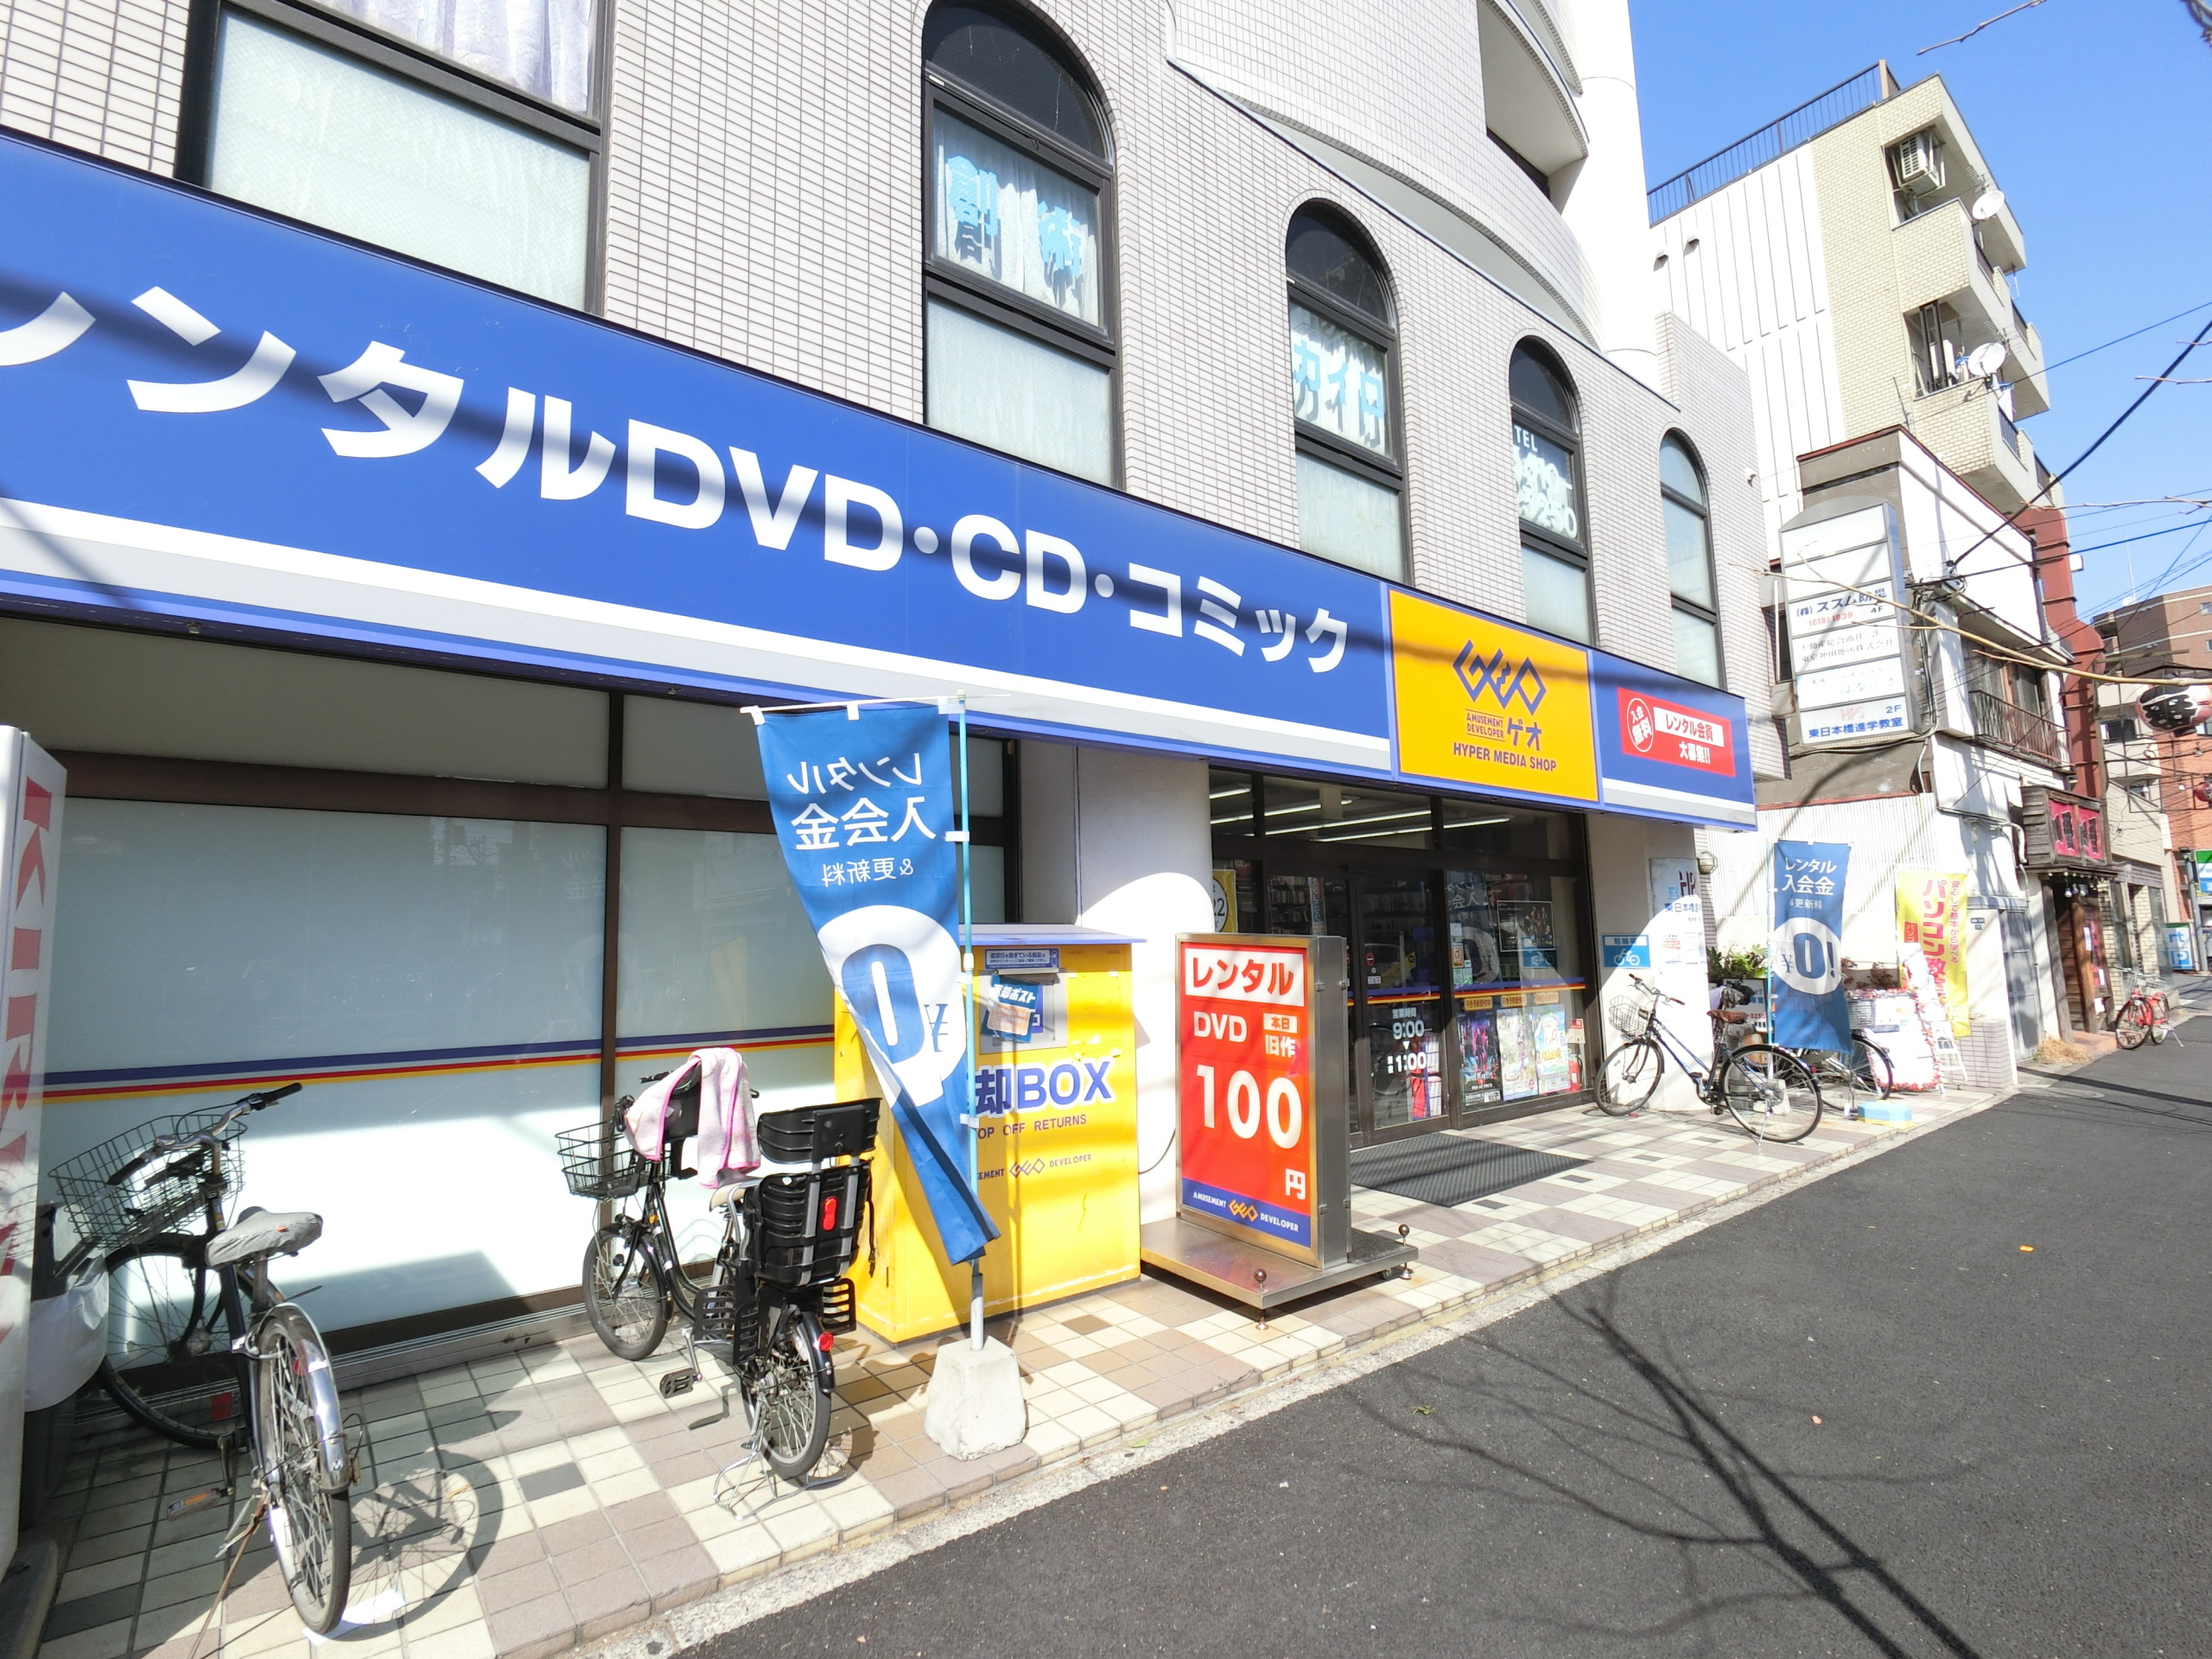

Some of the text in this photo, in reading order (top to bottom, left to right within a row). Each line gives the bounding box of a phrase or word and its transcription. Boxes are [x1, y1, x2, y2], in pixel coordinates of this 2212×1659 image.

[1293, 340, 1386, 419] カイロ
[1515, 424, 1538, 452] TEL
[1466, 713, 1503, 728] AMUSEMENT
[1885, 704, 1902, 714] 2F
[1467, 723, 1504, 739] DEVELOPER
[1507, 717, 1542, 752] ゲオ
[1666, 714, 1713, 741] レンタル会員
[1808, 716, 1904, 739] 東日本橋進学教室
[1453, 742, 1556, 772] HYPER MEDIA SHOP
[1784, 857, 1837, 874] レンタル
[1782, 874, 1835, 896] 入会金
[1193, 957, 1294, 996] レンタル
[1271, 1016, 1290, 1030] 本日
[1392, 1007, 1417, 1019] 営業時間
[1193, 1011, 1247, 1043] DVD
[1393, 1020, 1425, 1039] 9:00
[1265, 1034, 1296, 1058] 旧作
[1395, 1052, 1427, 1072] 1:00
[1197, 1065, 1302, 1149] 100
[1002, 1122, 1026, 1136] OFF
[1033, 1114, 1087, 1132] RETURNS
[1049, 1154, 1092, 1167] DEVELOPER
[1285, 1168, 1306, 1200] 円
[1193, 1192, 1226, 1209] AMUSEMENT
[1260, 1212, 1299, 1232] DEVELOPER
